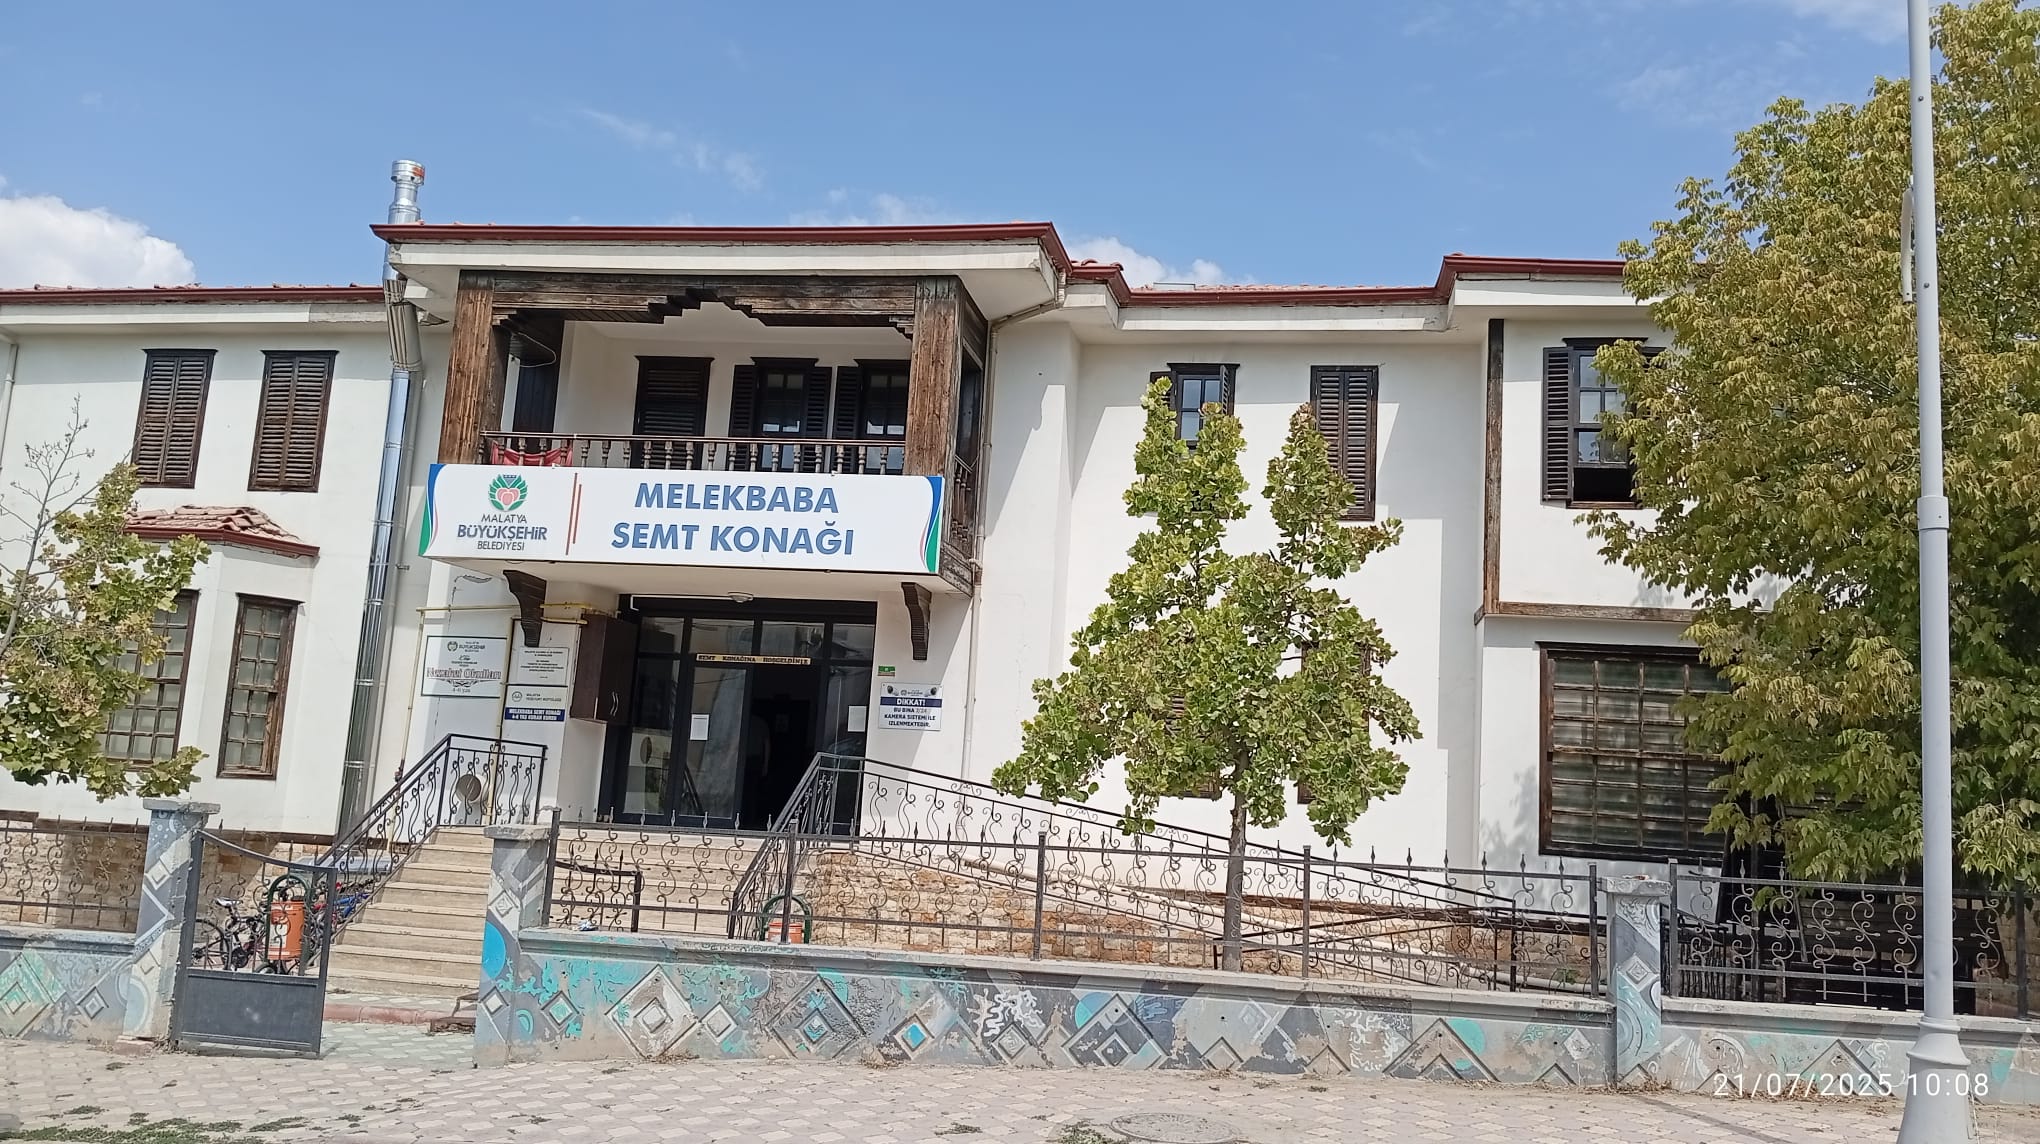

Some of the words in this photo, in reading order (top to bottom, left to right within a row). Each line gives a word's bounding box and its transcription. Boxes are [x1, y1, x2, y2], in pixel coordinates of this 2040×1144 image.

[634, 482, 839, 513] MELEKBABA
[481, 513, 527, 523] MALATYA
[611, 522, 700, 550] SEMT
[710, 520, 854, 555] KONAĞI
